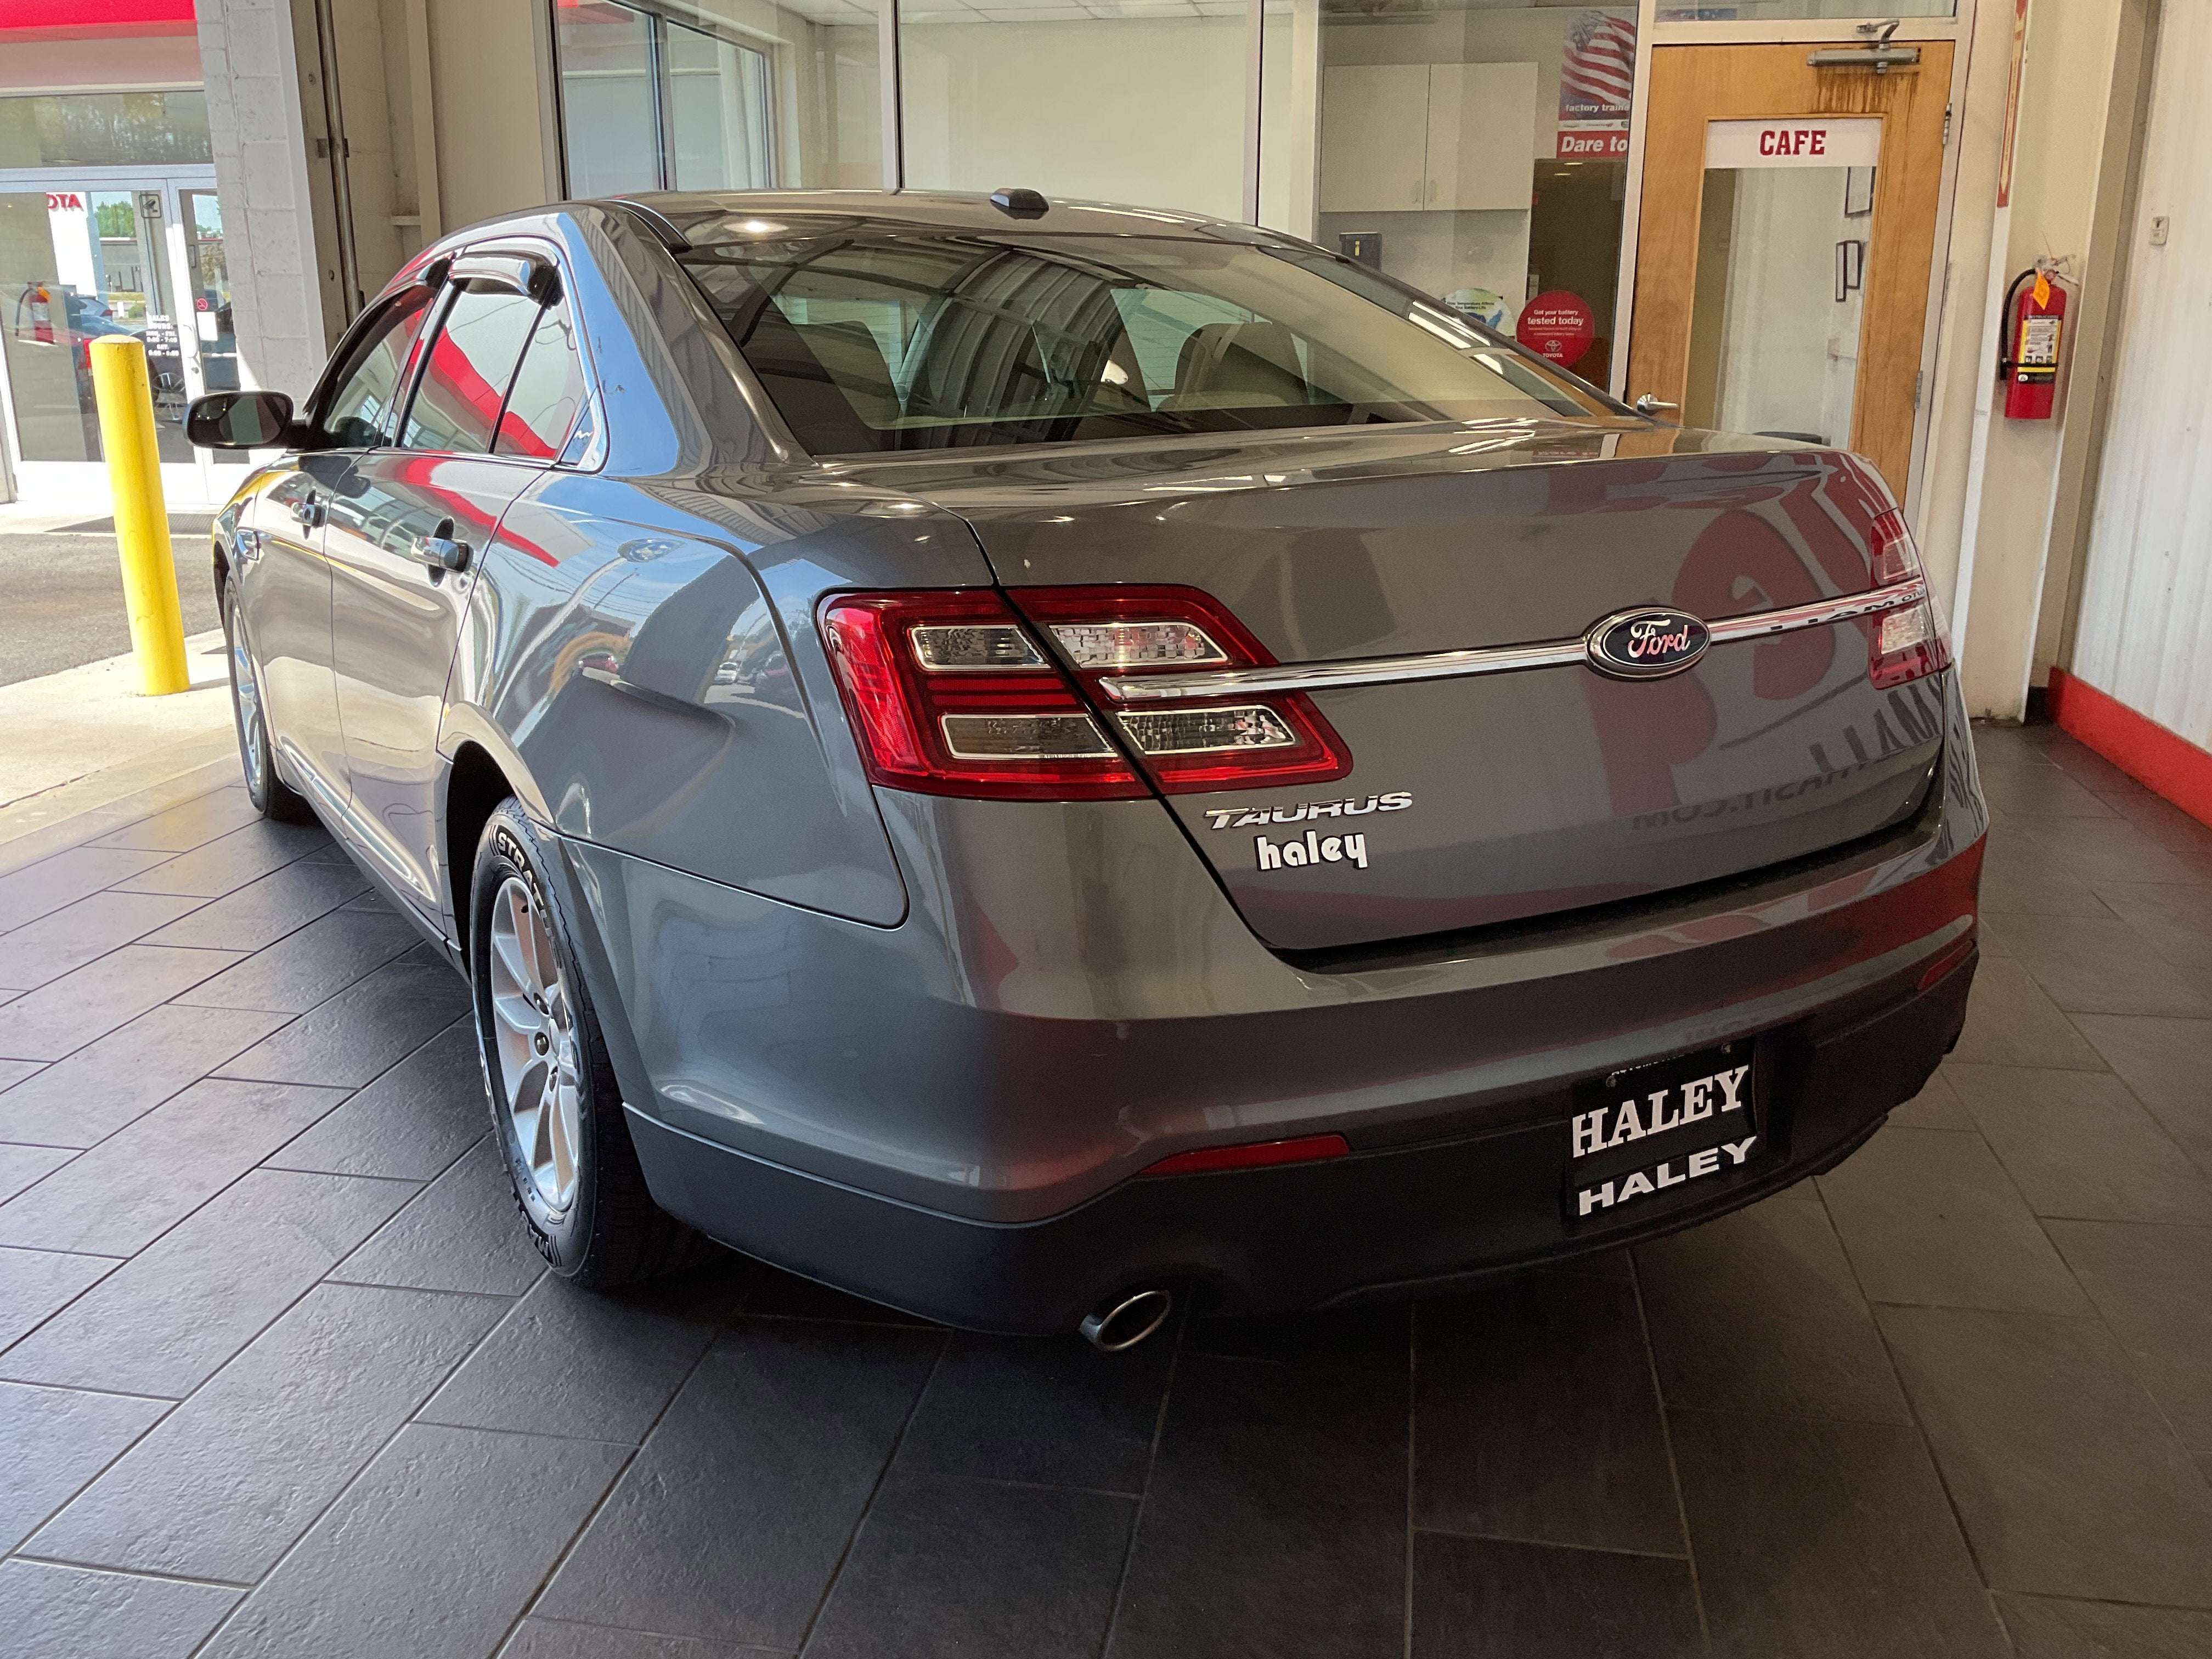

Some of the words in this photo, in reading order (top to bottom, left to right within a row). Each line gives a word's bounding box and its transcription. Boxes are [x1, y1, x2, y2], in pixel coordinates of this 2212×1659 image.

[1566, 104, 1599, 112] factory
[1561, 136, 1604, 153] Dare
[1610, 136, 1628, 152] to
[1759, 129, 1826, 155] CAFE
[1527, 317, 1556, 325] tested
[1559, 317, 1584, 326] today
[1627, 619, 1691, 658] Ford
[1204, 791, 1414, 830] TAURUS
[1254, 829, 1370, 871] haley
[1572, 1064, 1750, 1159] HALEY
[1579, 1136, 1757, 1216] HALEY
